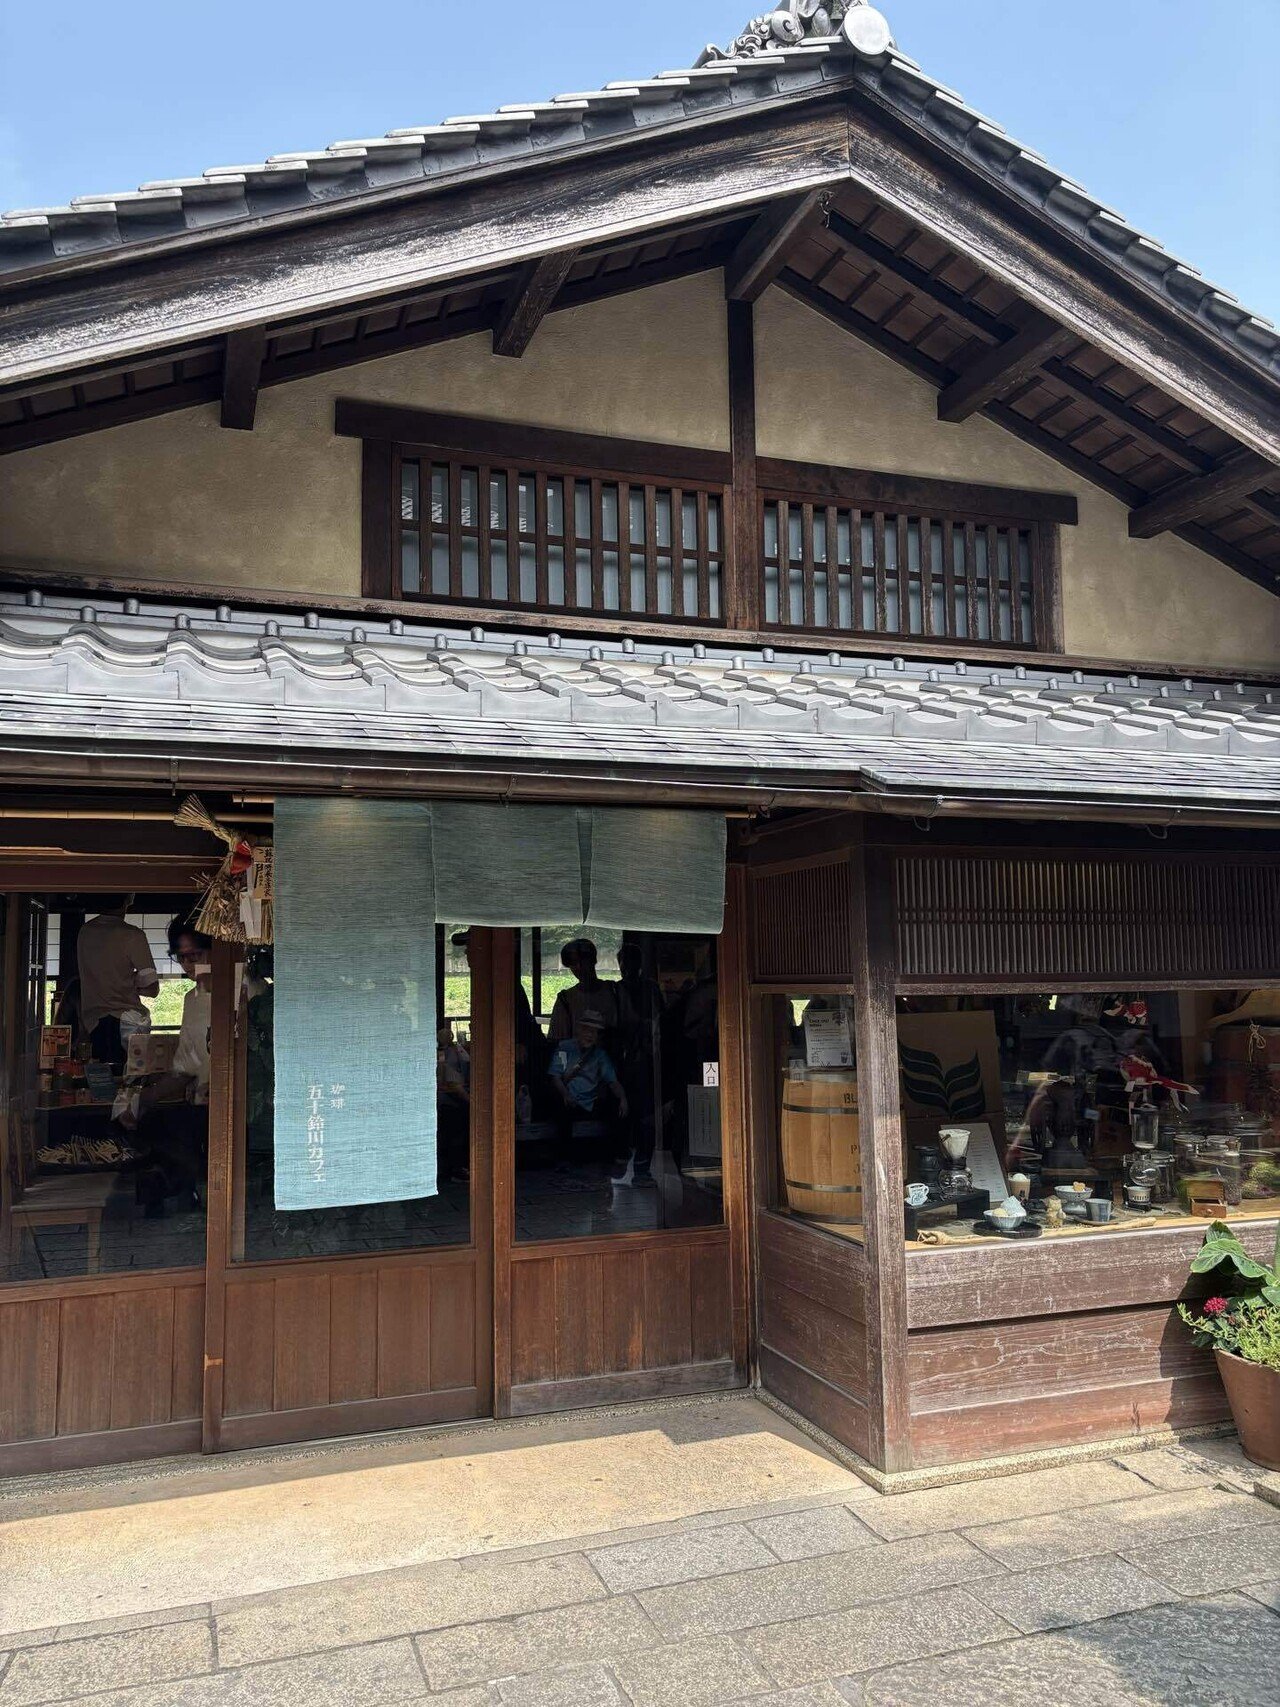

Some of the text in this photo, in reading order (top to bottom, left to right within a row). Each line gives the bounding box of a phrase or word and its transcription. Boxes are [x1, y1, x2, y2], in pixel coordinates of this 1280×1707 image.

[705, 1063, 716, 1085] 入口
[329, 1083, 346, 1110] 珈琲
[306, 1083, 327, 1183] 五十鈴川カフェ
